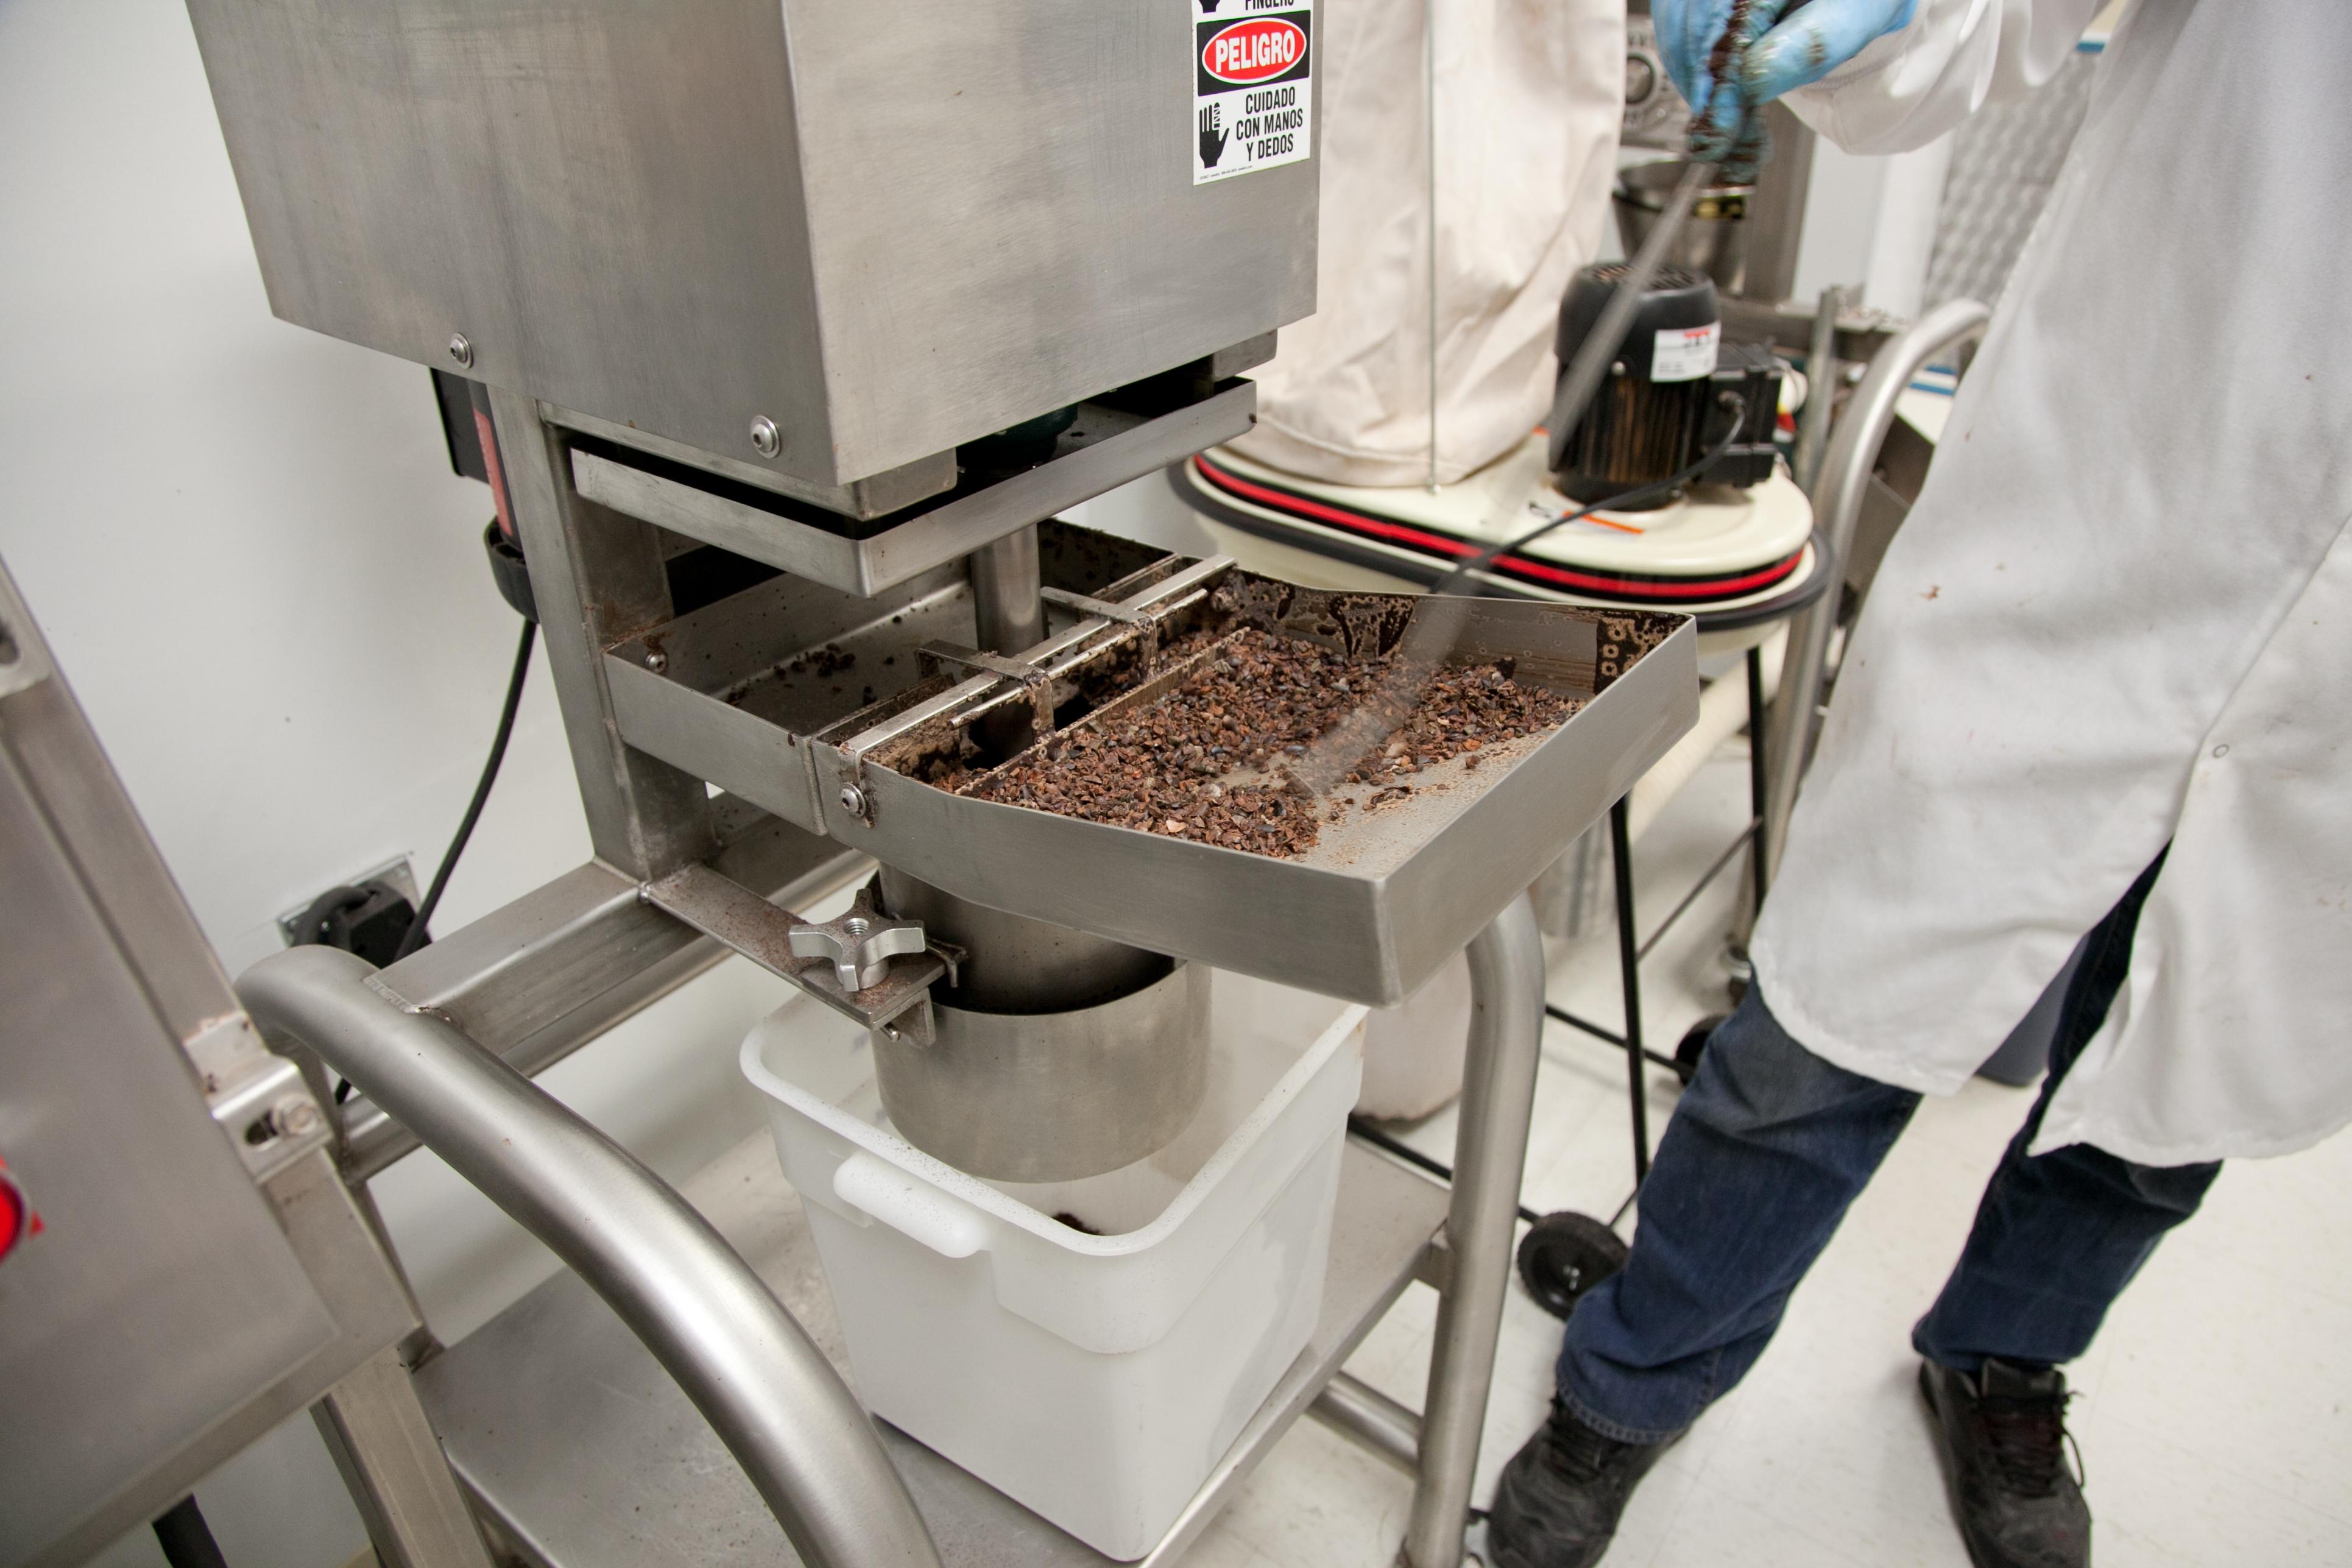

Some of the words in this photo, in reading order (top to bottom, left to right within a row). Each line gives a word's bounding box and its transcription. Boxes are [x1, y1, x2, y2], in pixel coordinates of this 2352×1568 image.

[1215, 29, 1296, 73] PELIGRO
[1246, 86, 1295, 115] CUIDADO
[1236, 117, 1260, 141] CON
[1264, 108, 1303, 135] MANOS
[1246, 141, 1254, 161] Y
[1258, 133, 1293, 160] DEDOS
